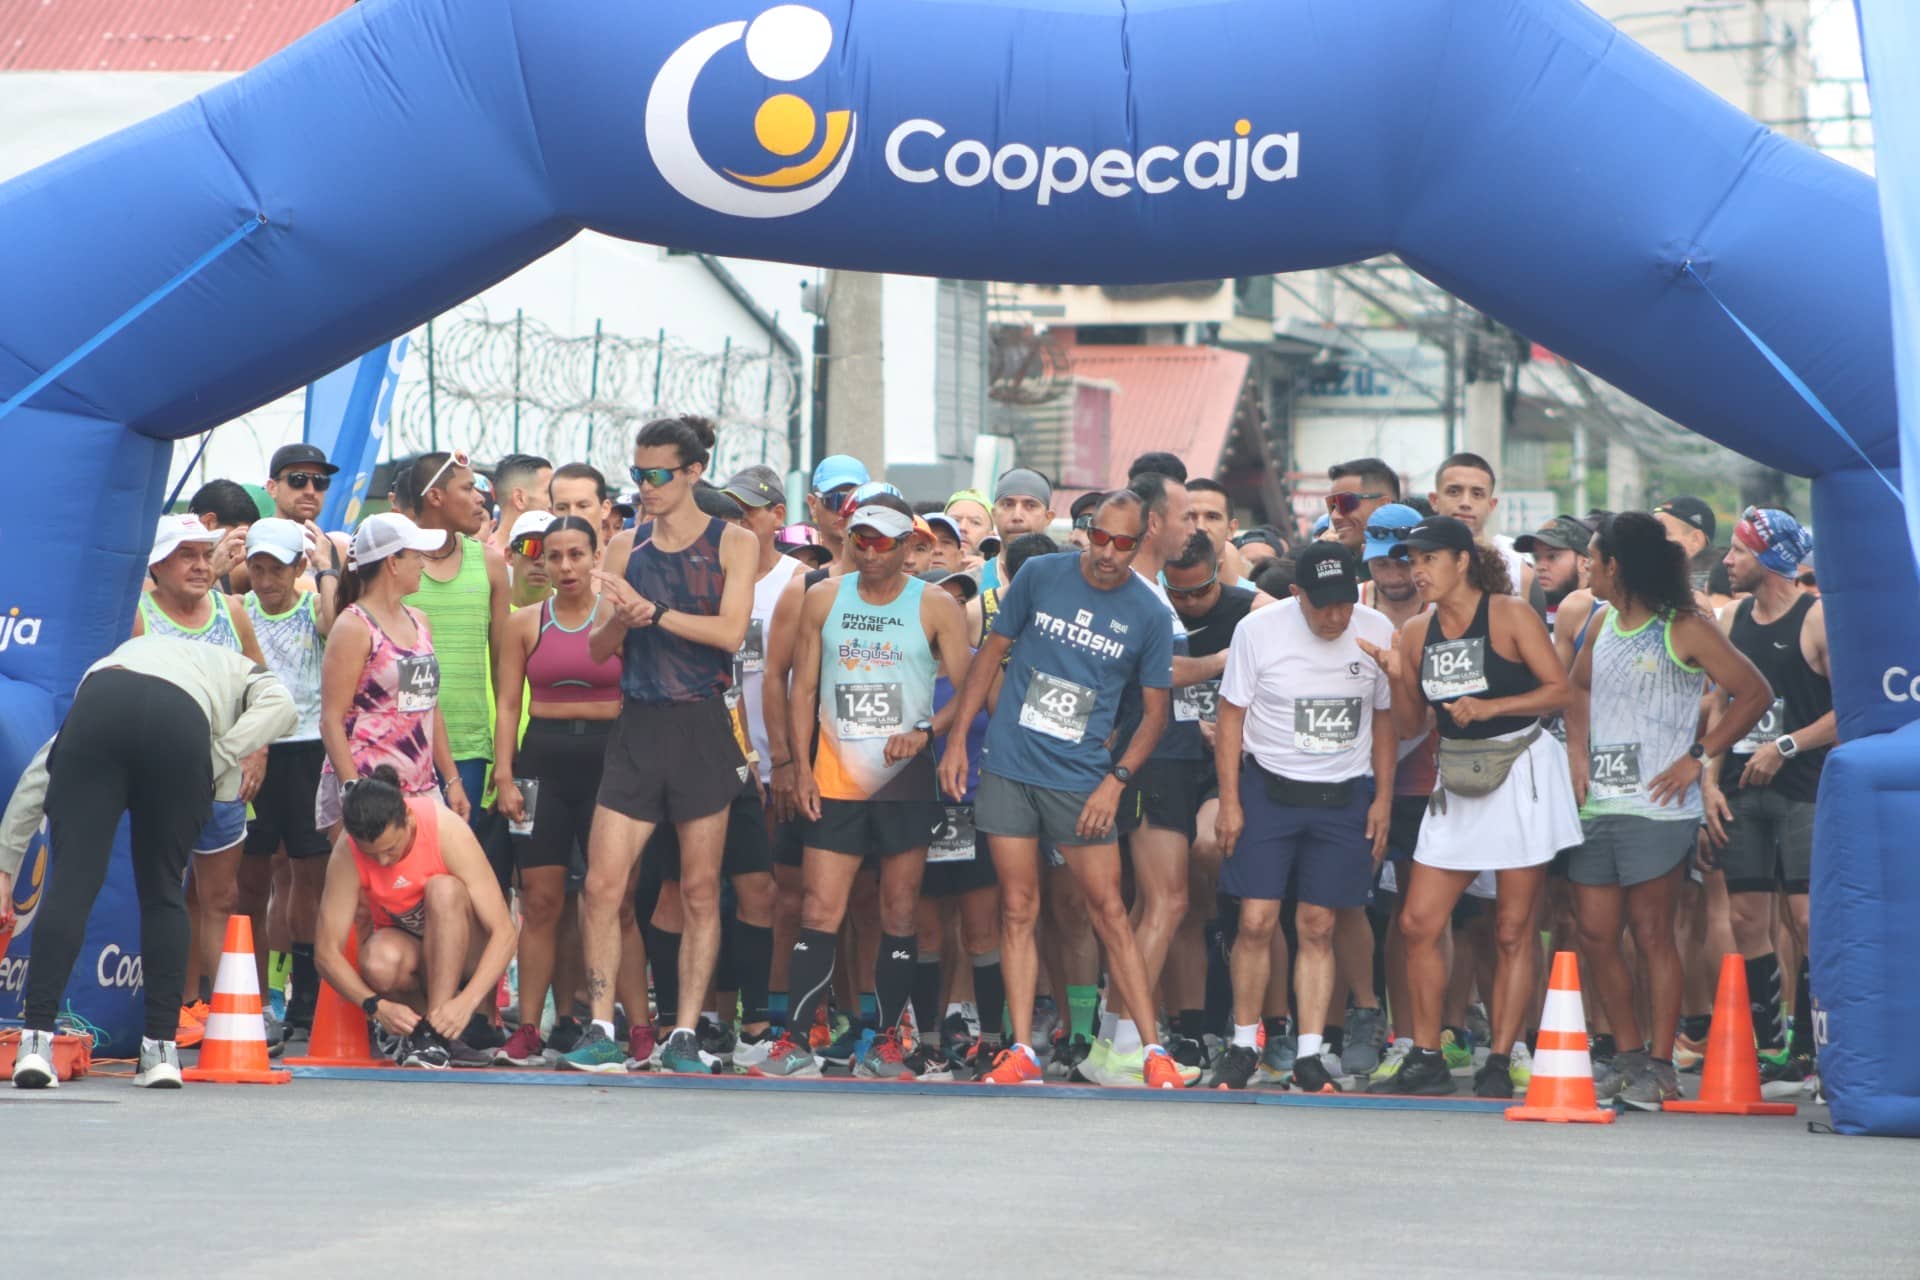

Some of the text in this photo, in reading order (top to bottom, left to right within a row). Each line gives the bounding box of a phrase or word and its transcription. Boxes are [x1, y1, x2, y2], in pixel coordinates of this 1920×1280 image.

[884, 119, 1299, 206] Coopecaja
[0, 607, 42, 652] ja
[842, 612, 904, 627] PHYSICAL
[850, 621, 884, 632] ZONE
[1034, 611, 1125, 659] MATOSHI
[1430, 648, 1473, 678] 184
[411, 664, 435, 689] 44
[844, 692, 890, 717] 145
[1040, 687, 1078, 717] 48
[1305, 708, 1353, 732] 144
[1593, 753, 1629, 779] 214
